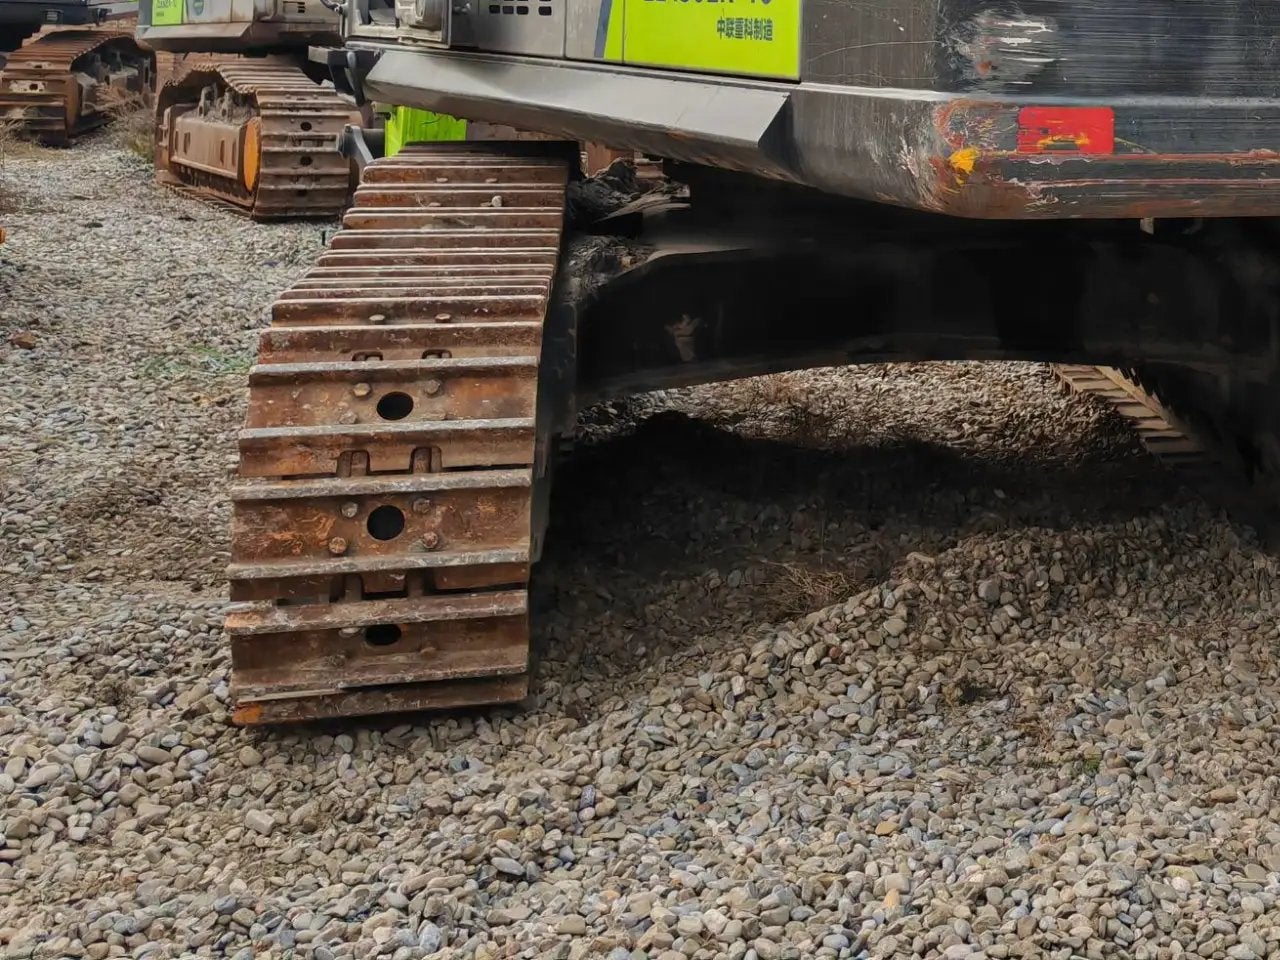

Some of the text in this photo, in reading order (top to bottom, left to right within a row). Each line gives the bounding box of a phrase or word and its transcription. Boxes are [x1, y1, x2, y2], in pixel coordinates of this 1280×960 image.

[716, 16, 773, 41] 中联重科制造
